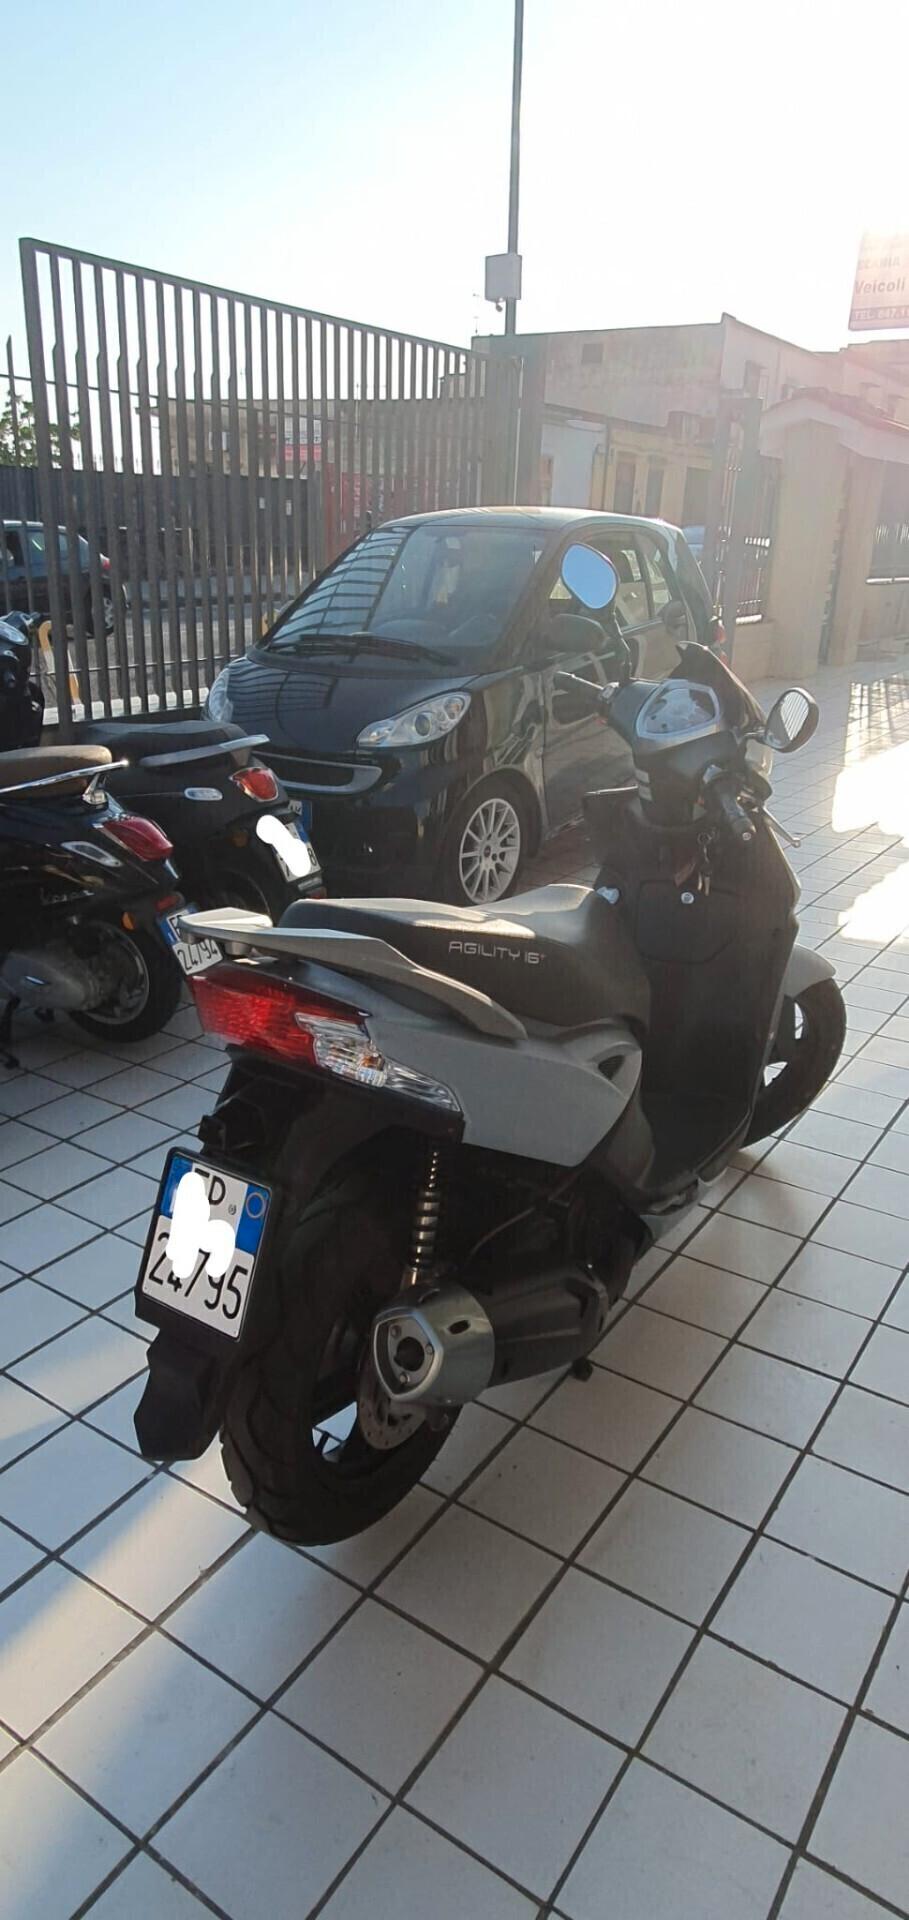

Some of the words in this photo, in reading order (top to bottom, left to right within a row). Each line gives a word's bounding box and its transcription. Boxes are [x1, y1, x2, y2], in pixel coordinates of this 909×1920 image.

[854, 277, 905, 294] Veicoli
[448, 941, 521, 961] AGILITY
[194, 1167, 226, 1206] D
